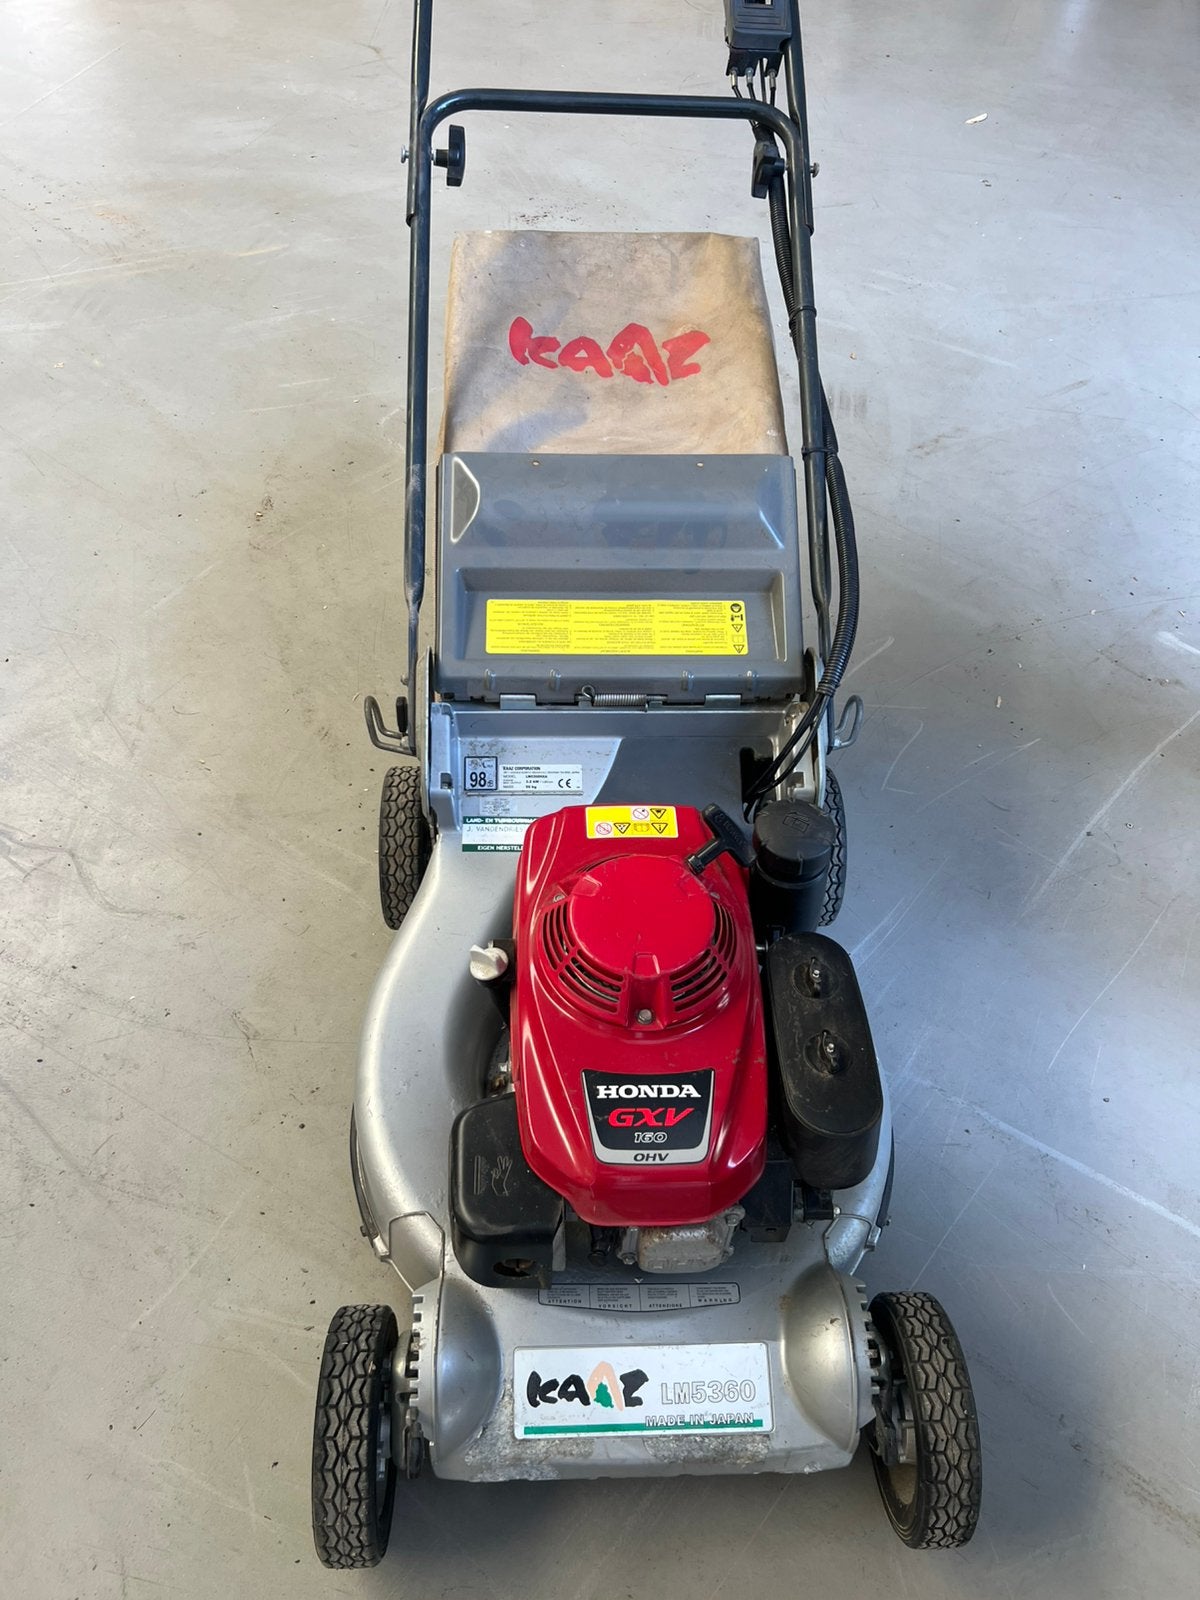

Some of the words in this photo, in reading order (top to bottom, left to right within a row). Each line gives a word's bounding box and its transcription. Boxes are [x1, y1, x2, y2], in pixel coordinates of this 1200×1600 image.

[470, 771, 487, 788] 98
[596, 1084, 701, 1099] HONDA
[608, 1107, 695, 1127] GXV
[634, 1132, 668, 1144] 160
[633, 1153, 670, 1162] OHV
[660, 1379, 756, 1405] LM5360
[645, 1414, 686, 1428] MADE
[689, 1414, 706, 1426] IN
[709, 1412, 755, 1426] JAPAN
